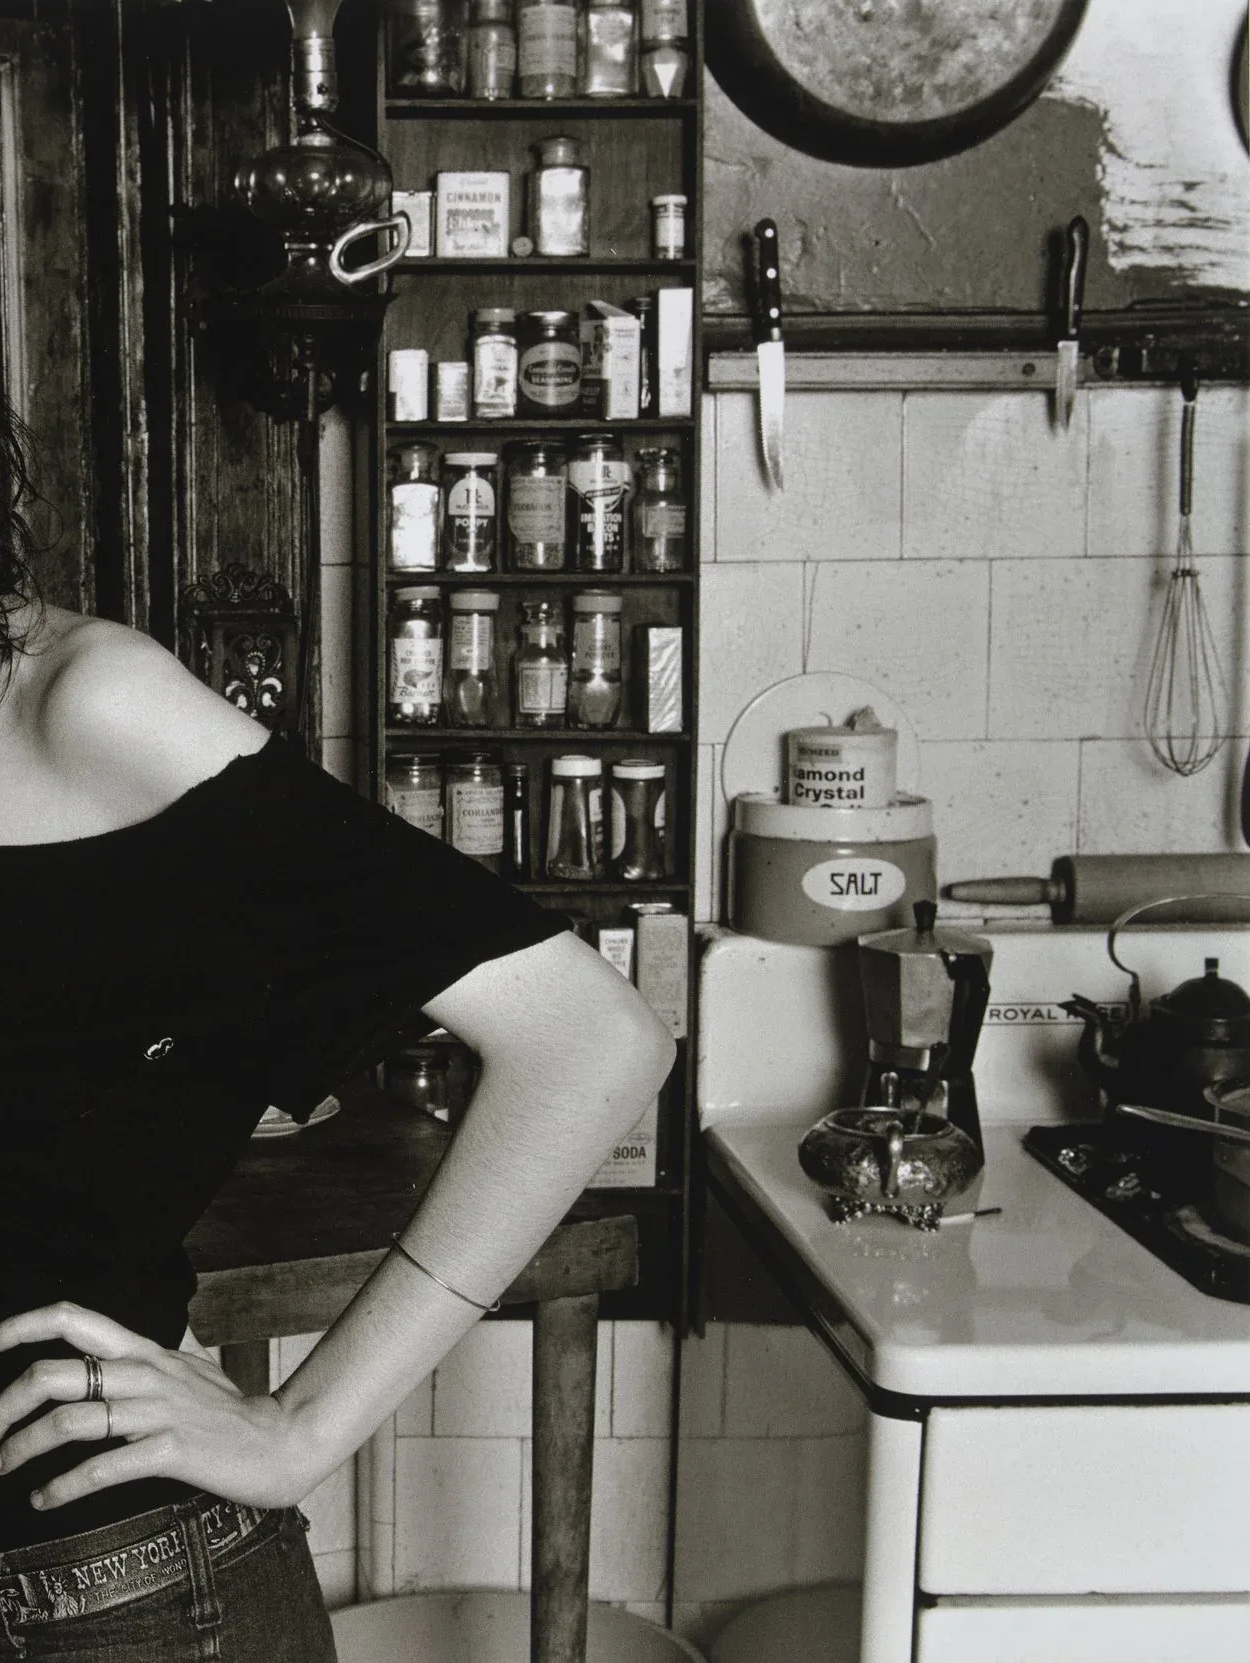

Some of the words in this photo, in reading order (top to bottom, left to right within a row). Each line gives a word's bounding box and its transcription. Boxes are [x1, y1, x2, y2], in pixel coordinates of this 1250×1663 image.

[446, 192, 501, 203] CINNAMON
[455, 518, 489, 527] POPY
[794, 782, 865, 803] Crystal
[830, 872, 883, 896] SALT
[989, 1008, 1058, 1021] ROYAL
[612, 1146, 647, 1160] SODA
[71, 1552, 128, 1590] NEW
